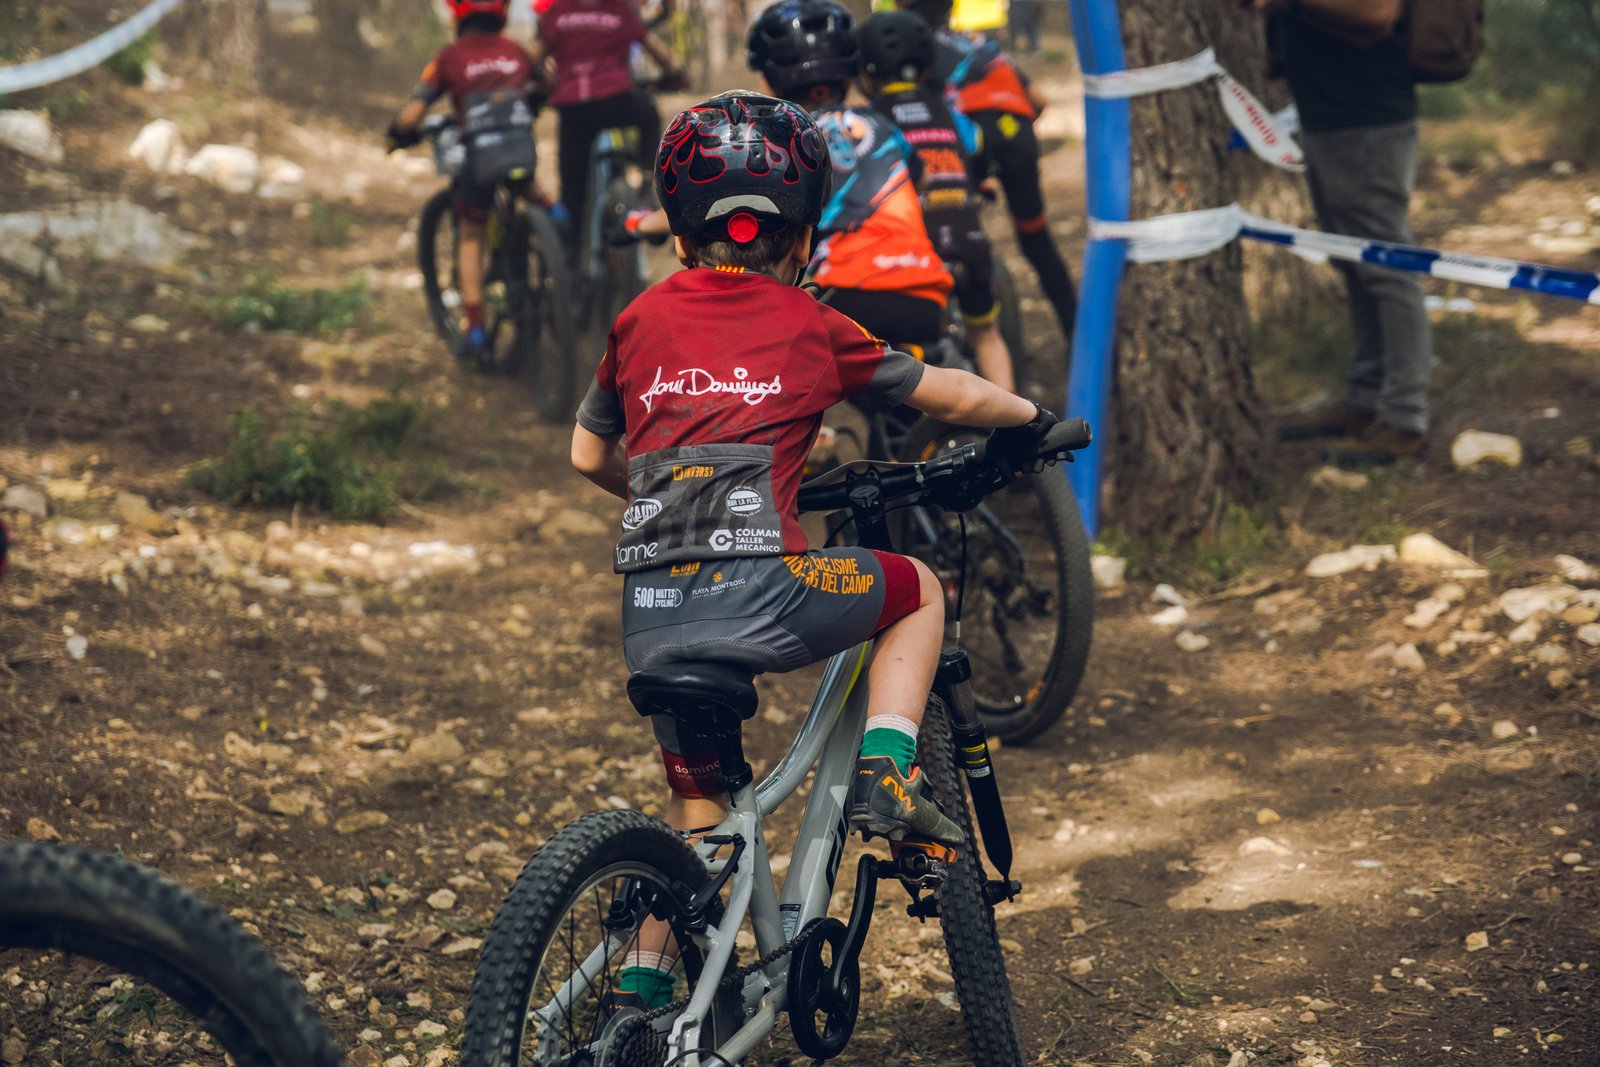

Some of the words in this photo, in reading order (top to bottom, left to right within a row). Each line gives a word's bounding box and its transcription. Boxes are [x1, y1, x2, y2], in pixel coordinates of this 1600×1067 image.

[735, 528, 780, 538] COLMAN
[735, 536, 764, 545] TALLER
[735, 543, 780, 553] MECANICO
[821, 571, 838, 593] DEL
[841, 574, 874, 595] CAMP
[634, 586, 655, 609] 500
[655, 588, 676, 599] WATTS
[655, 598, 675, 608] CYCLING
